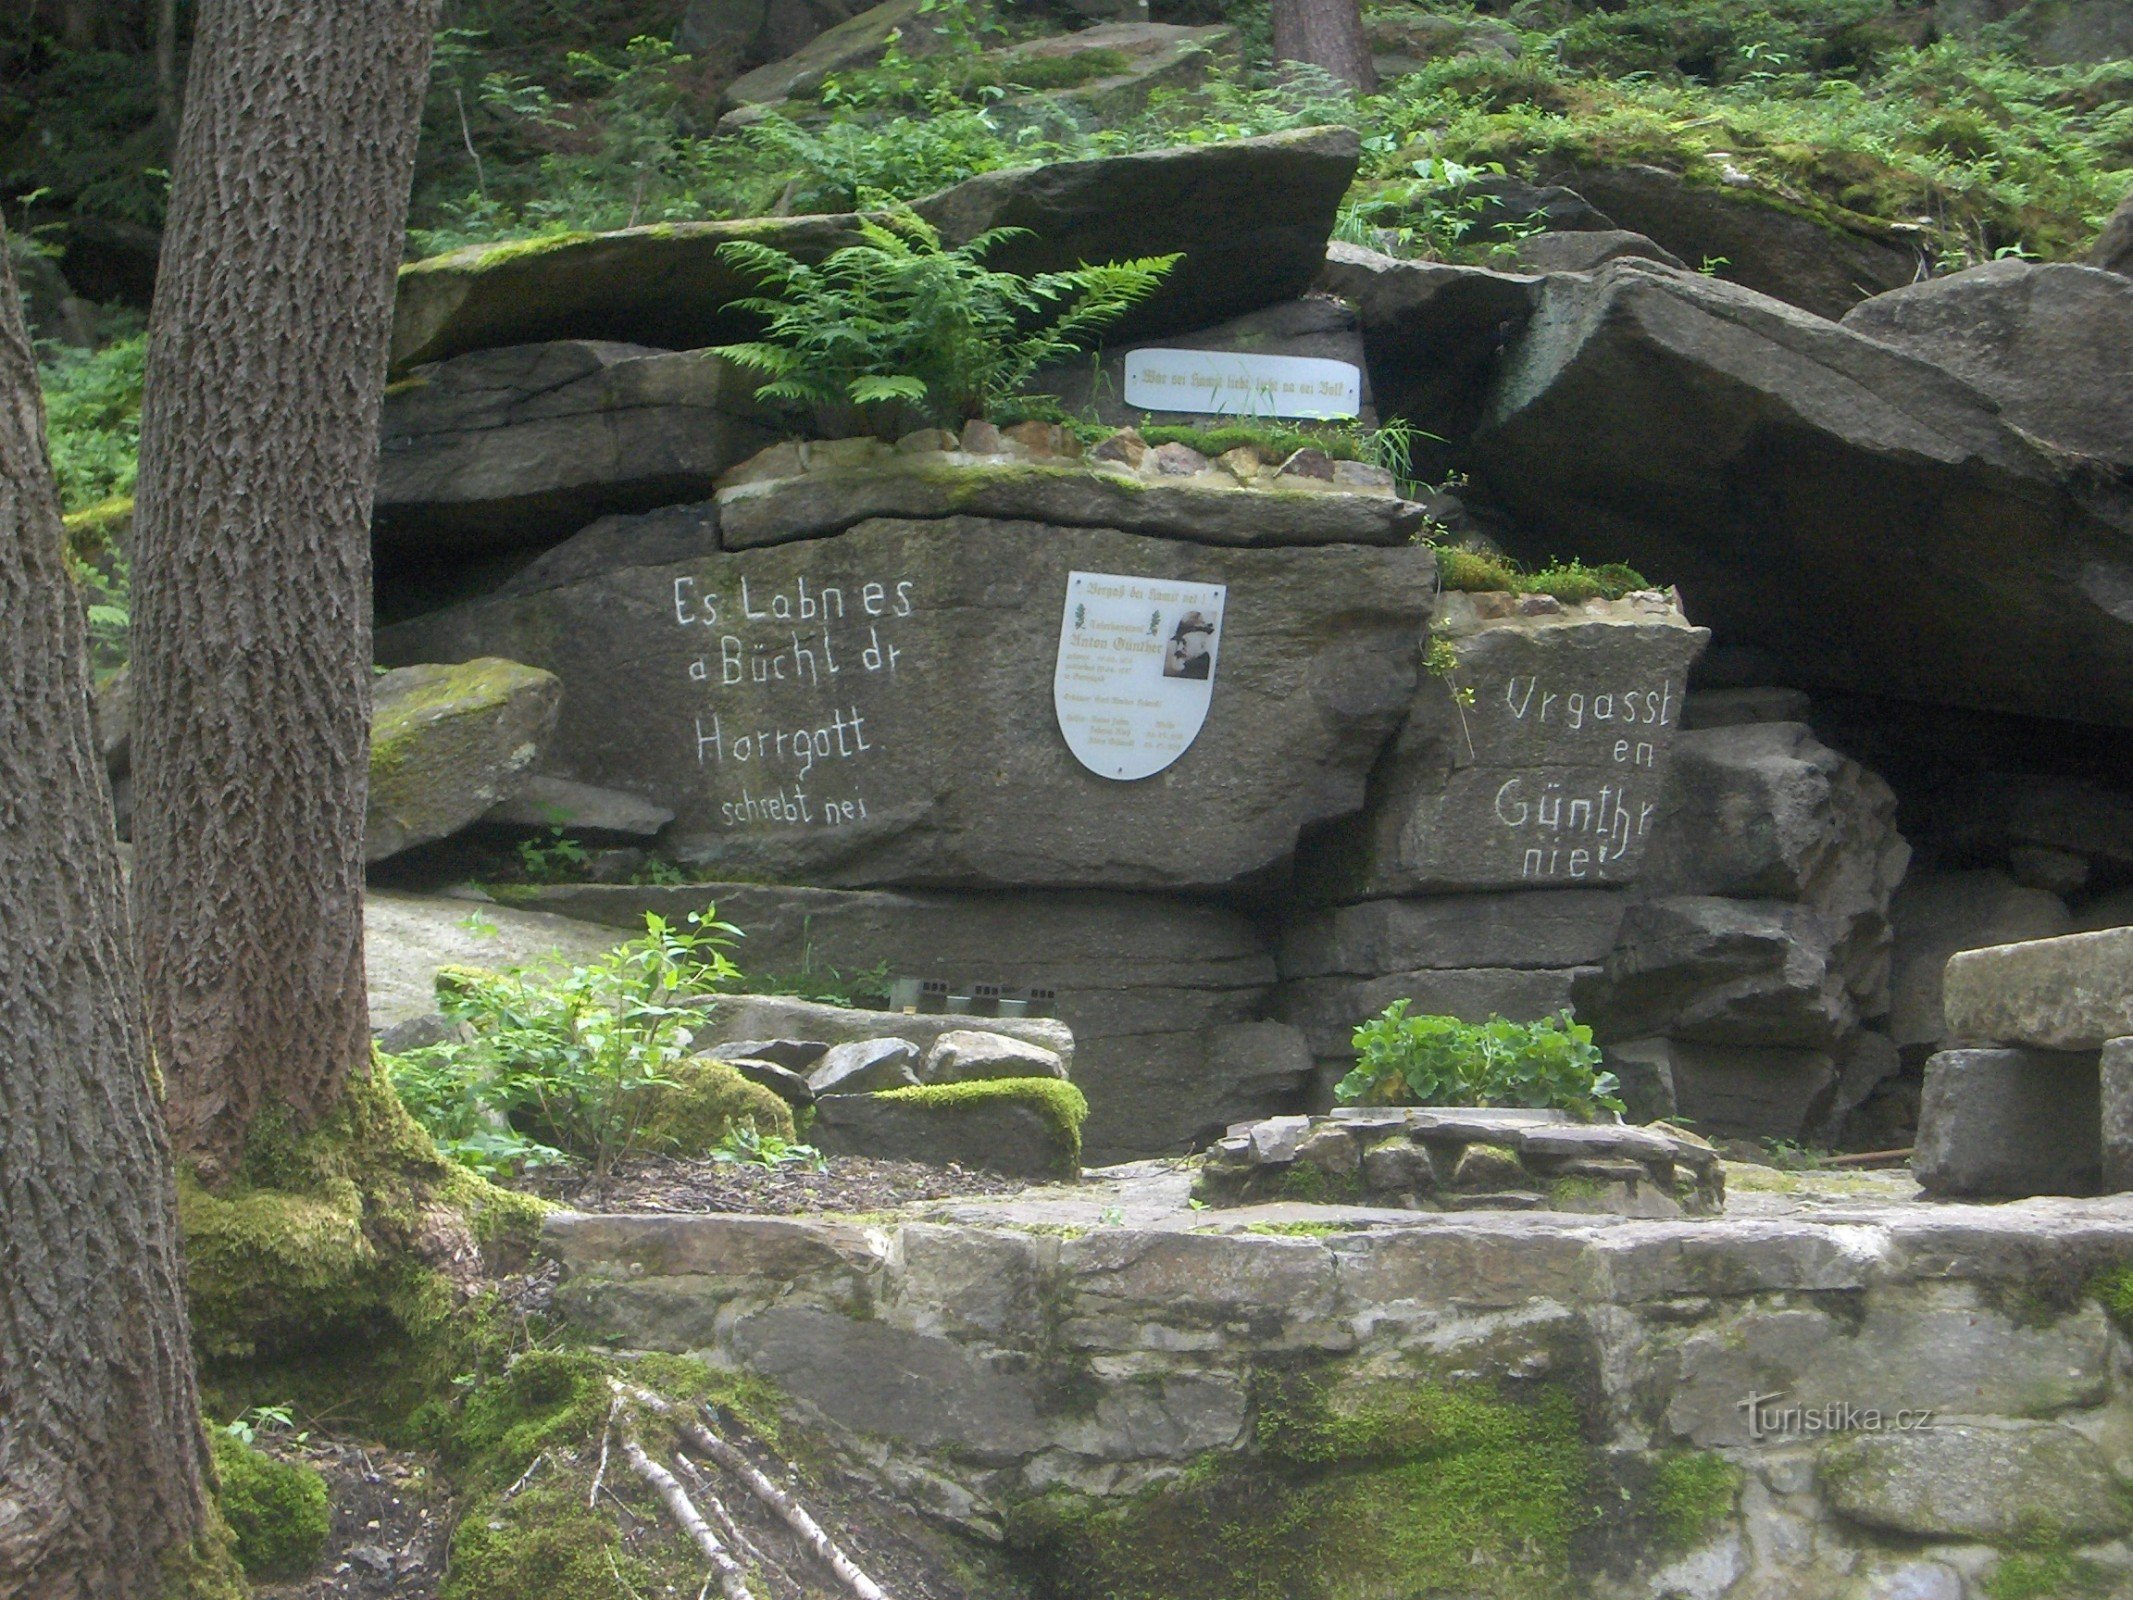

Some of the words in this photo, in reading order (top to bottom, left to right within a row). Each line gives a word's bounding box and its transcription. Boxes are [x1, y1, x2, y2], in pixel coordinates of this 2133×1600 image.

[675, 576, 718, 625] Es
[740, 575, 843, 621] Labn
[862, 581, 914, 617] es
[689, 658, 707, 681] a
[720, 627, 840, 686] Büchl
[862, 626, 901, 673] dr
[1506, 676, 1672, 730] Vrgasst
[1613, 739, 1654, 768] en
[721, 783, 813, 826] schrebt
[825, 785, 868, 825] nei
[1495, 778, 1654, 860] Günthr
[1522, 836, 1610, 879] nie!
